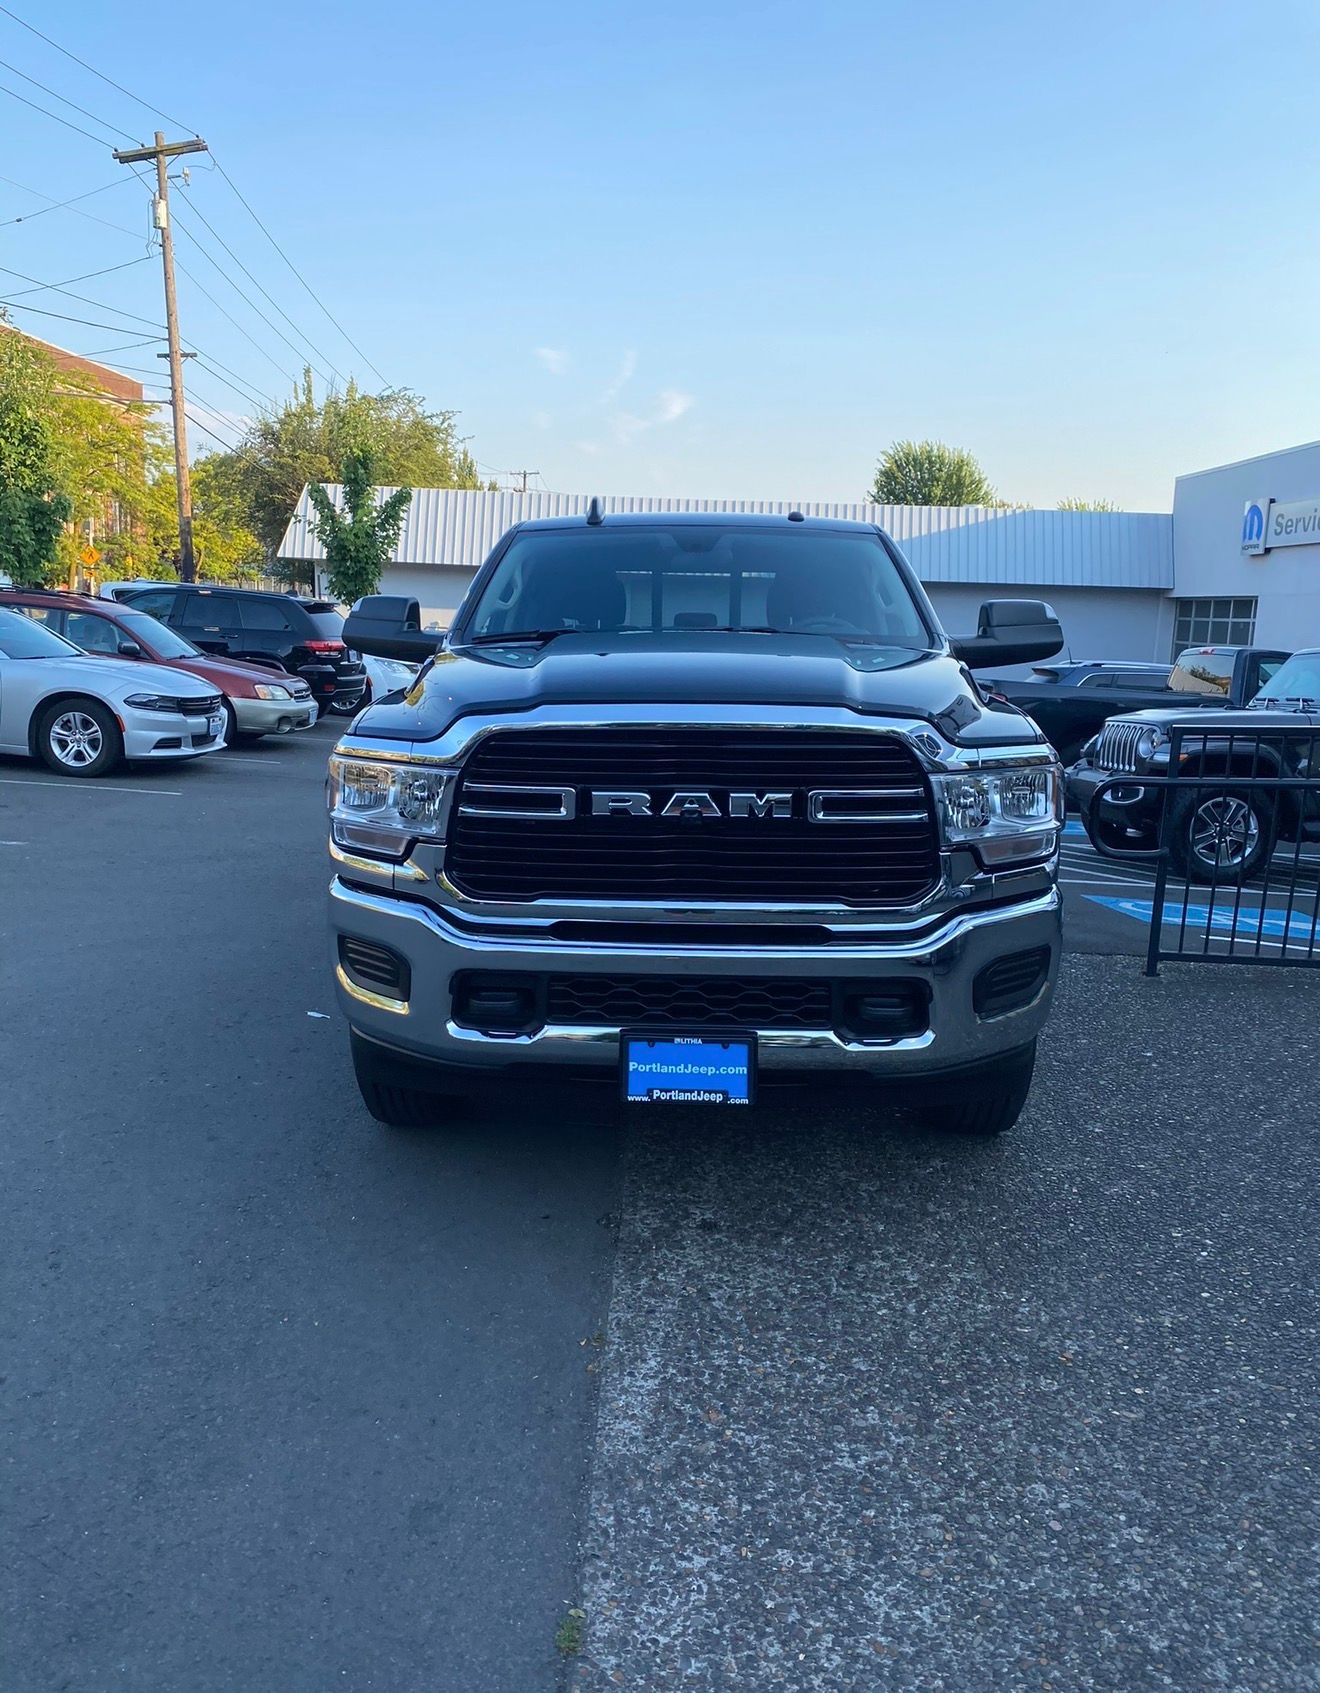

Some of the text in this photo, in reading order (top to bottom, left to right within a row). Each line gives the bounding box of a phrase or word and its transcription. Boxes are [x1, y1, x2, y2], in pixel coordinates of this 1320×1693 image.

[591, 791, 793, 818] RAM
[629, 1061, 748, 1075] PortlandJeep.com
[653, 1089, 723, 1103] PortlandJeep
